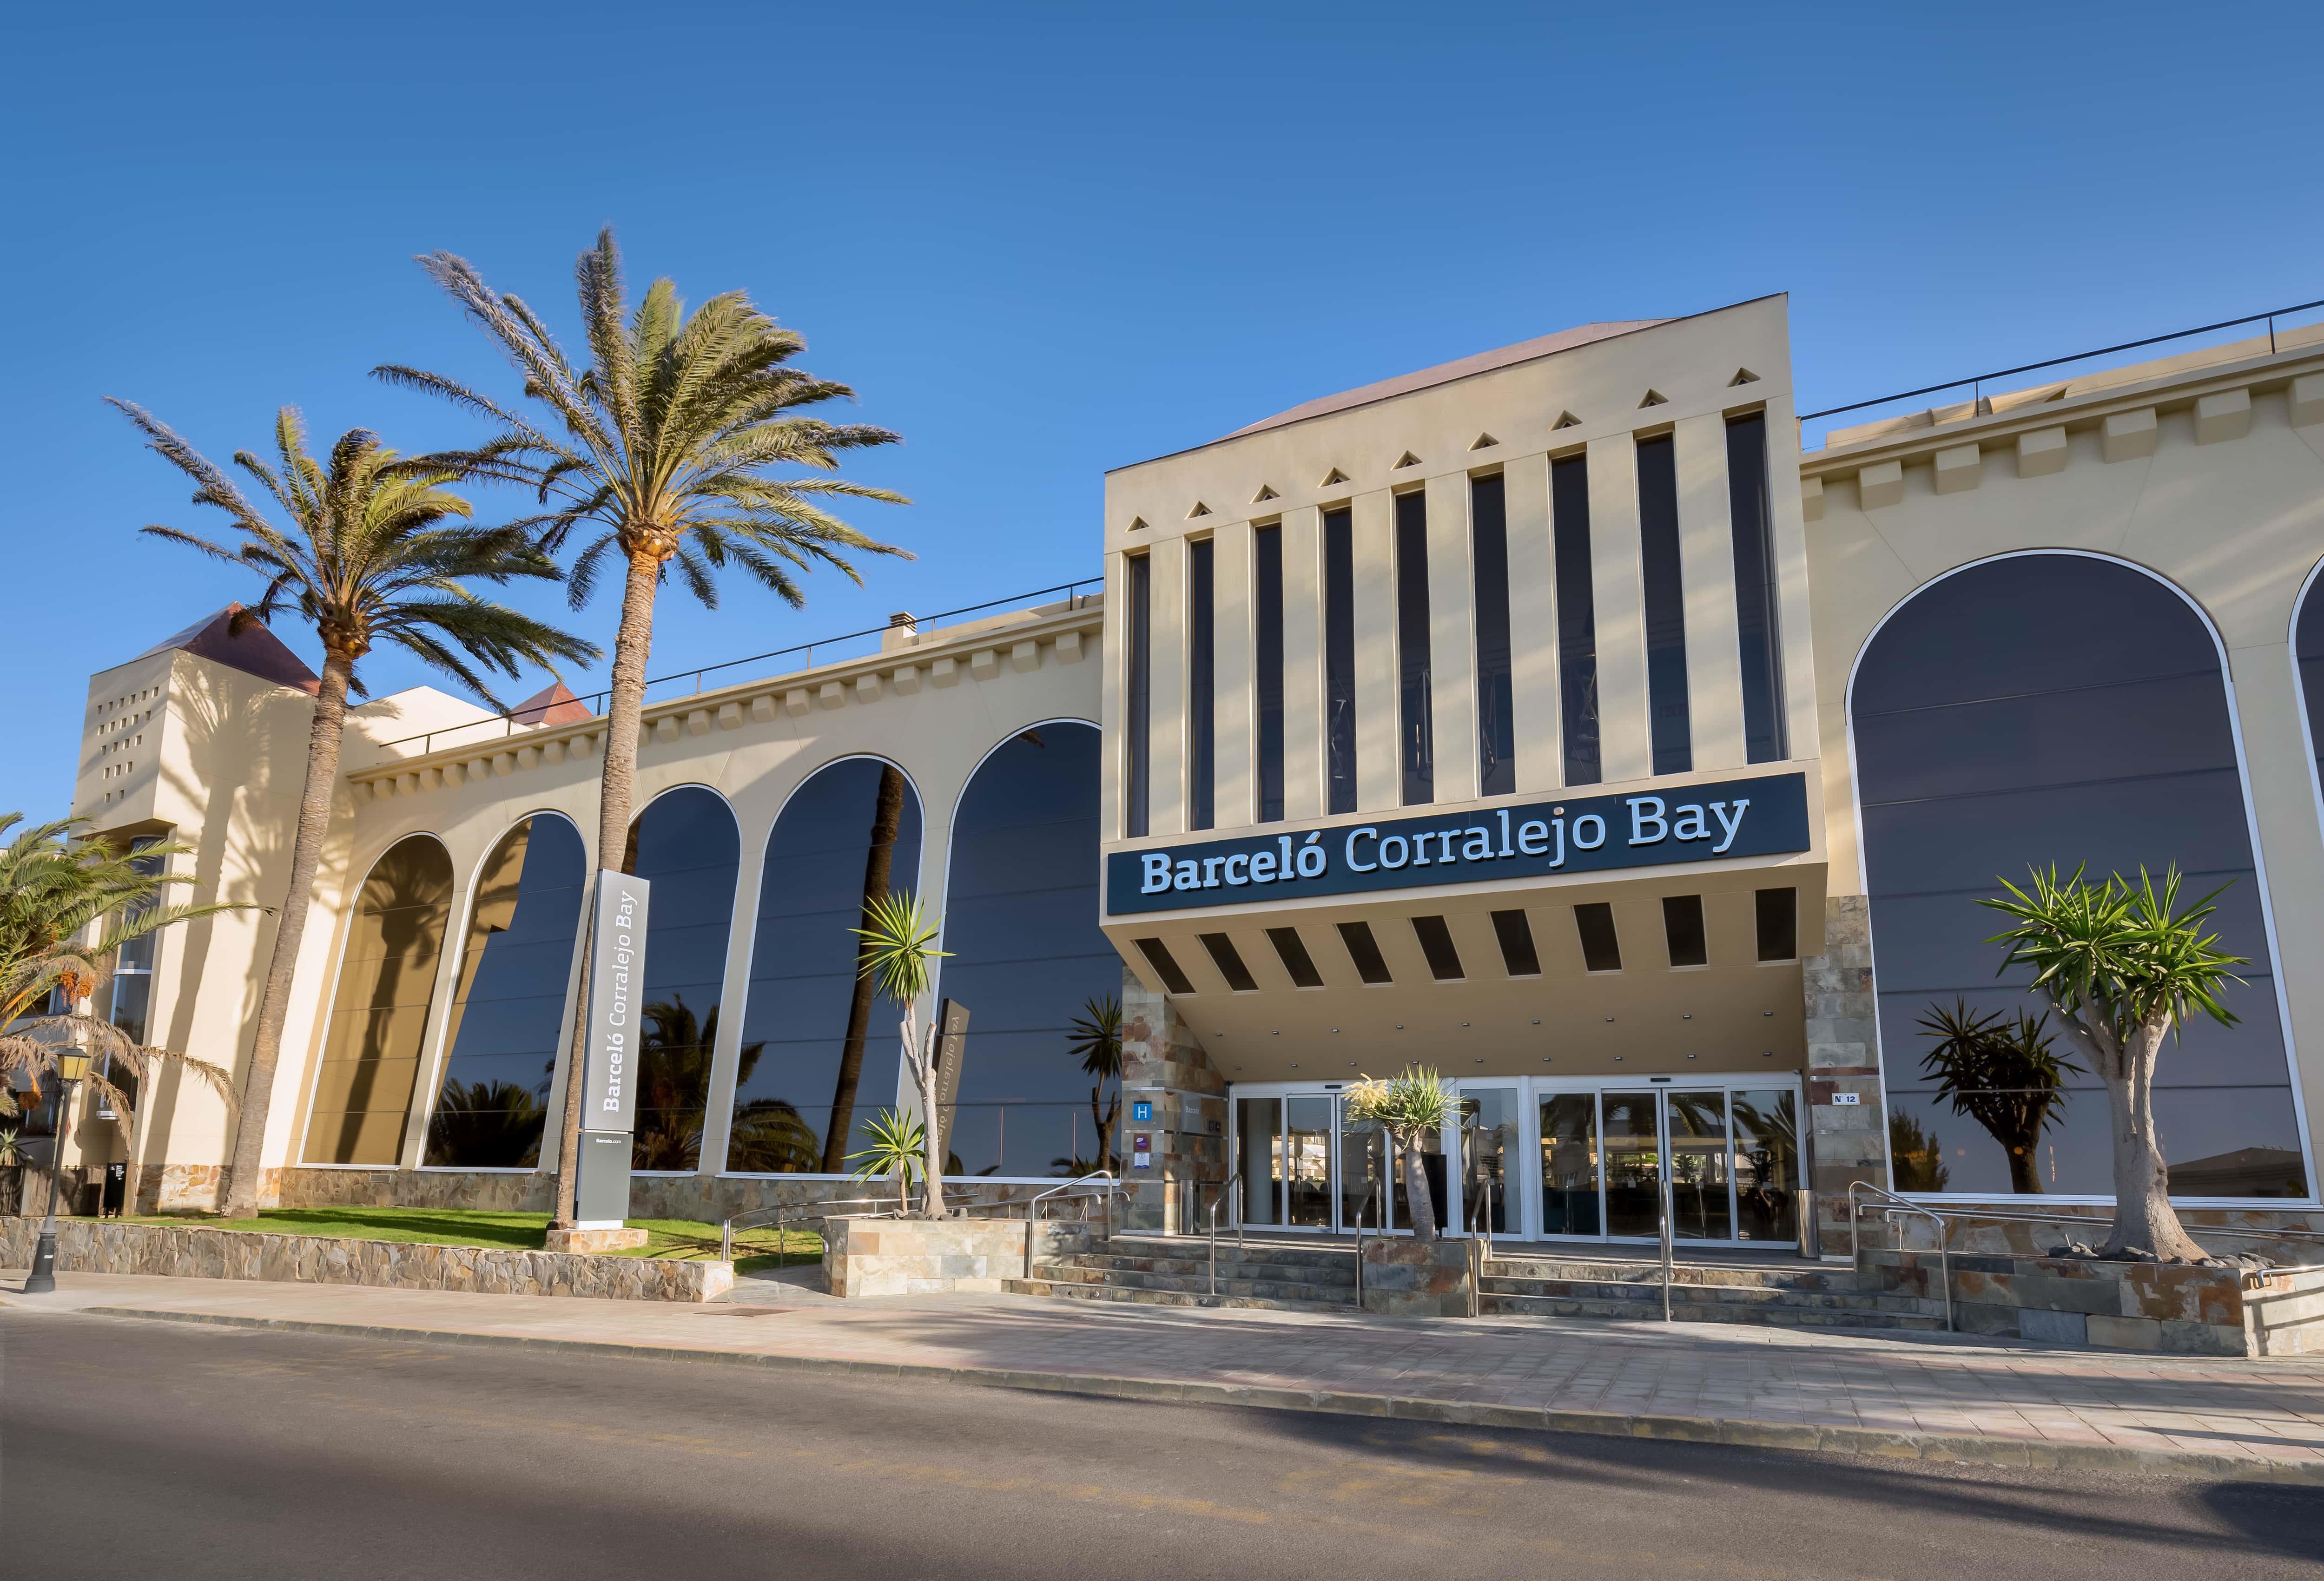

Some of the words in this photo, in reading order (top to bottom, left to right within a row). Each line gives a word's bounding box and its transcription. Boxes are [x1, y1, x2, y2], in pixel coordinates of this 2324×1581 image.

[1142, 831, 1327, 894] Barceló
[1346, 807, 1606, 872] Corralejo
[1626, 796, 1750, 853] Bay
[615, 890, 638, 930] Bay
[609, 934, 634, 1026] Corralejo
[603, 1033, 624, 1112] Barceló
[1138, 1106, 1147, 1119] H
